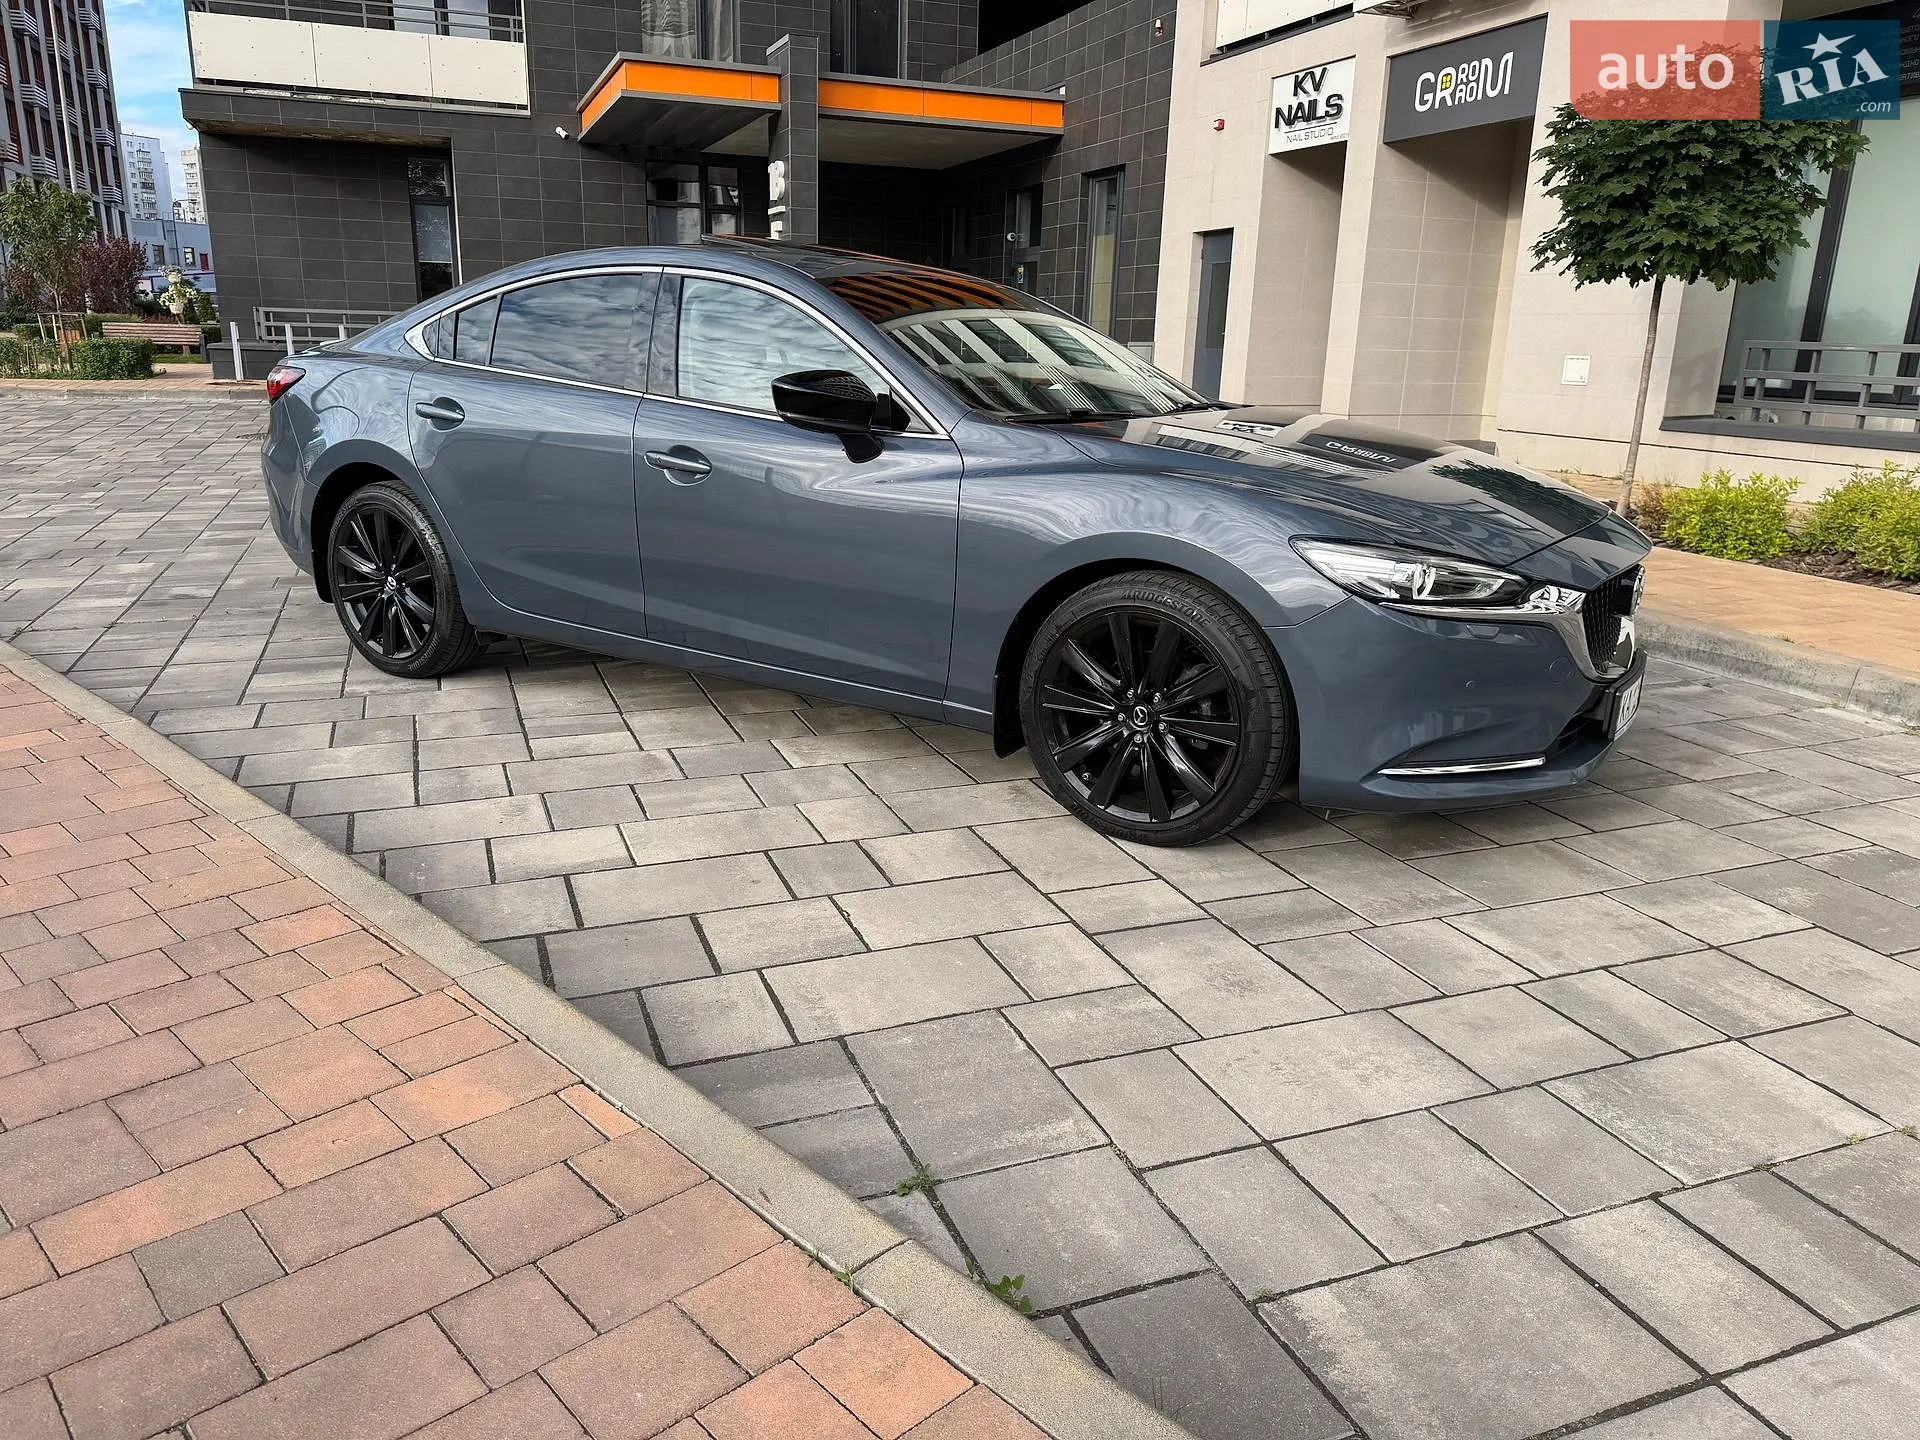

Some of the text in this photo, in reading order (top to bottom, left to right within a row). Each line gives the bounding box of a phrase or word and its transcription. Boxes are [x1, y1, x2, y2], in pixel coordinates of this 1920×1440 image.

[1293, 67, 1328, 98] KV
[1275, 94, 1344, 129] NAILS
[1286, 134, 1303, 143] NAIL
[1304, 127, 1334, 140] STUDIO
